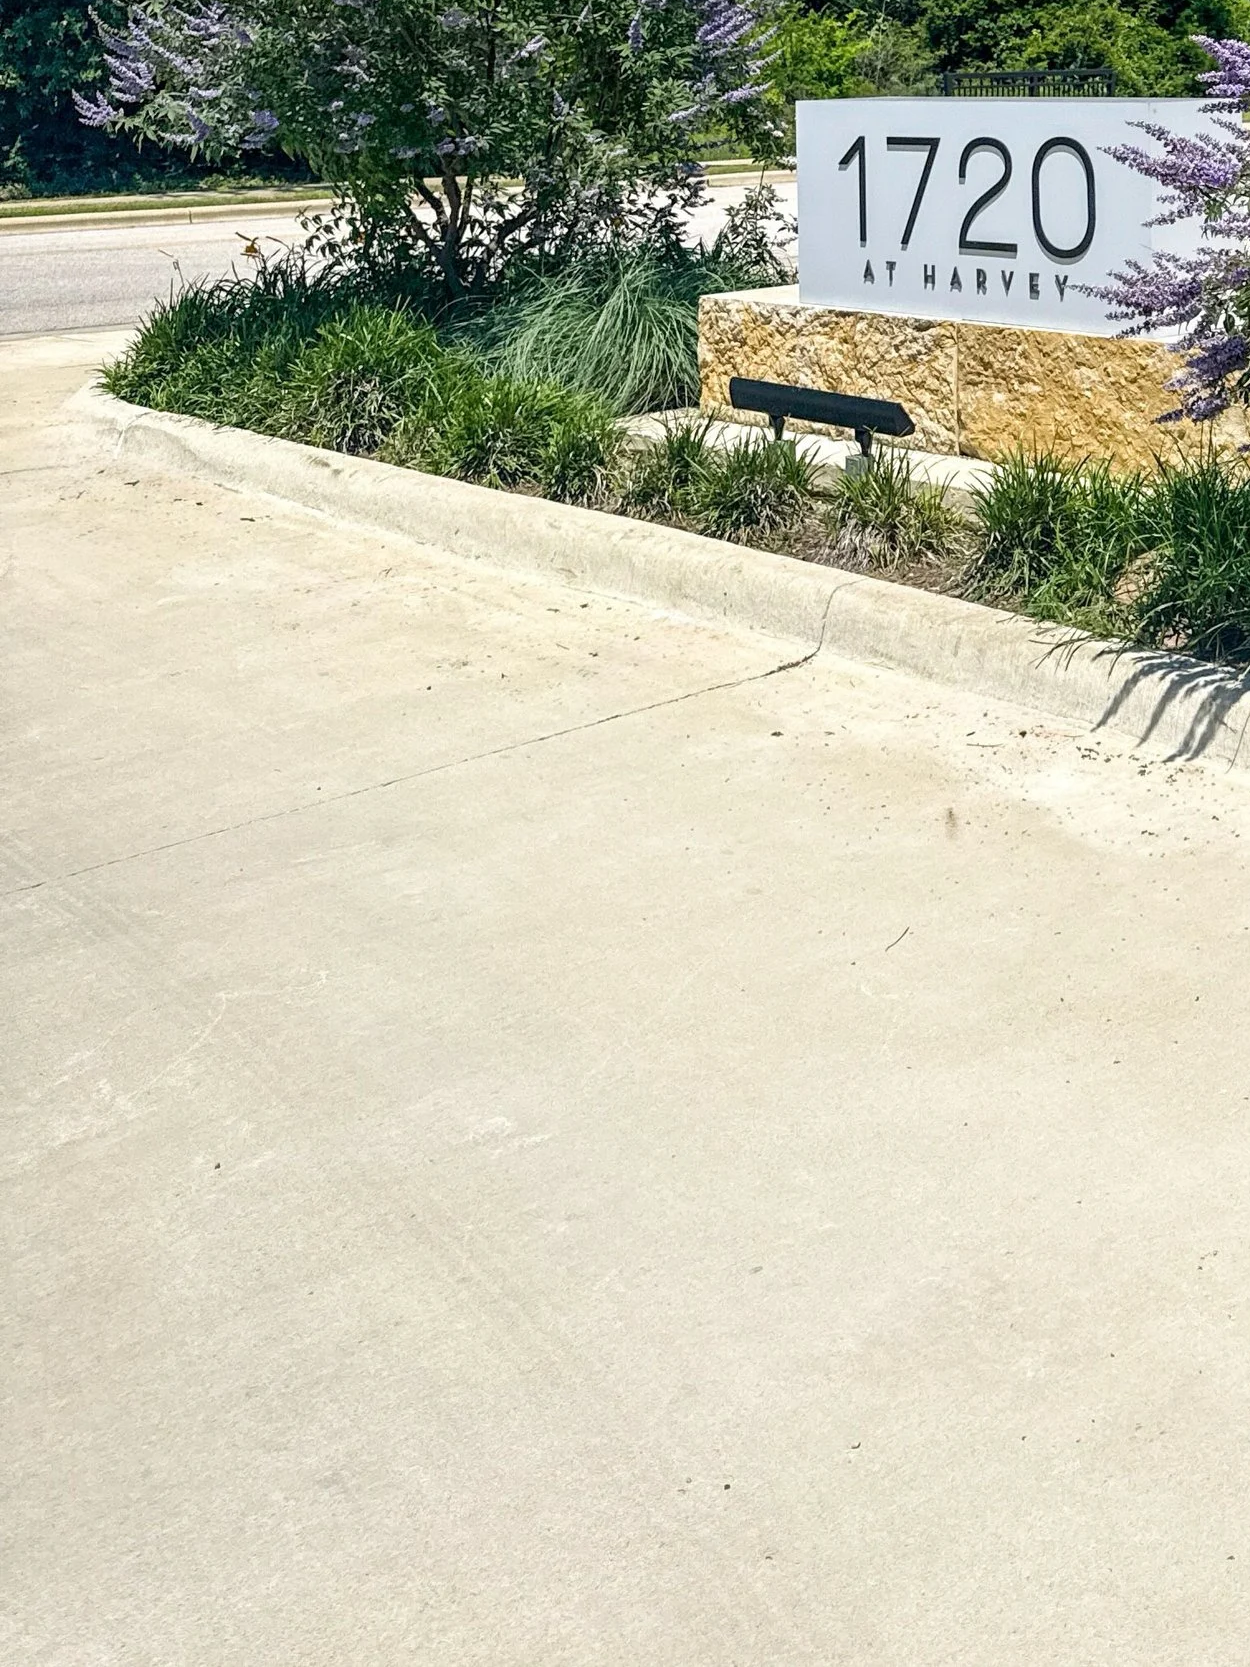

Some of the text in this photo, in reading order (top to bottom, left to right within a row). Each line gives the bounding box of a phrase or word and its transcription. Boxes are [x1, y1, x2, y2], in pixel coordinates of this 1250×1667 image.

[838, 135, 1096, 261] 1720
[863, 259, 1069, 302] AT HARVEY
